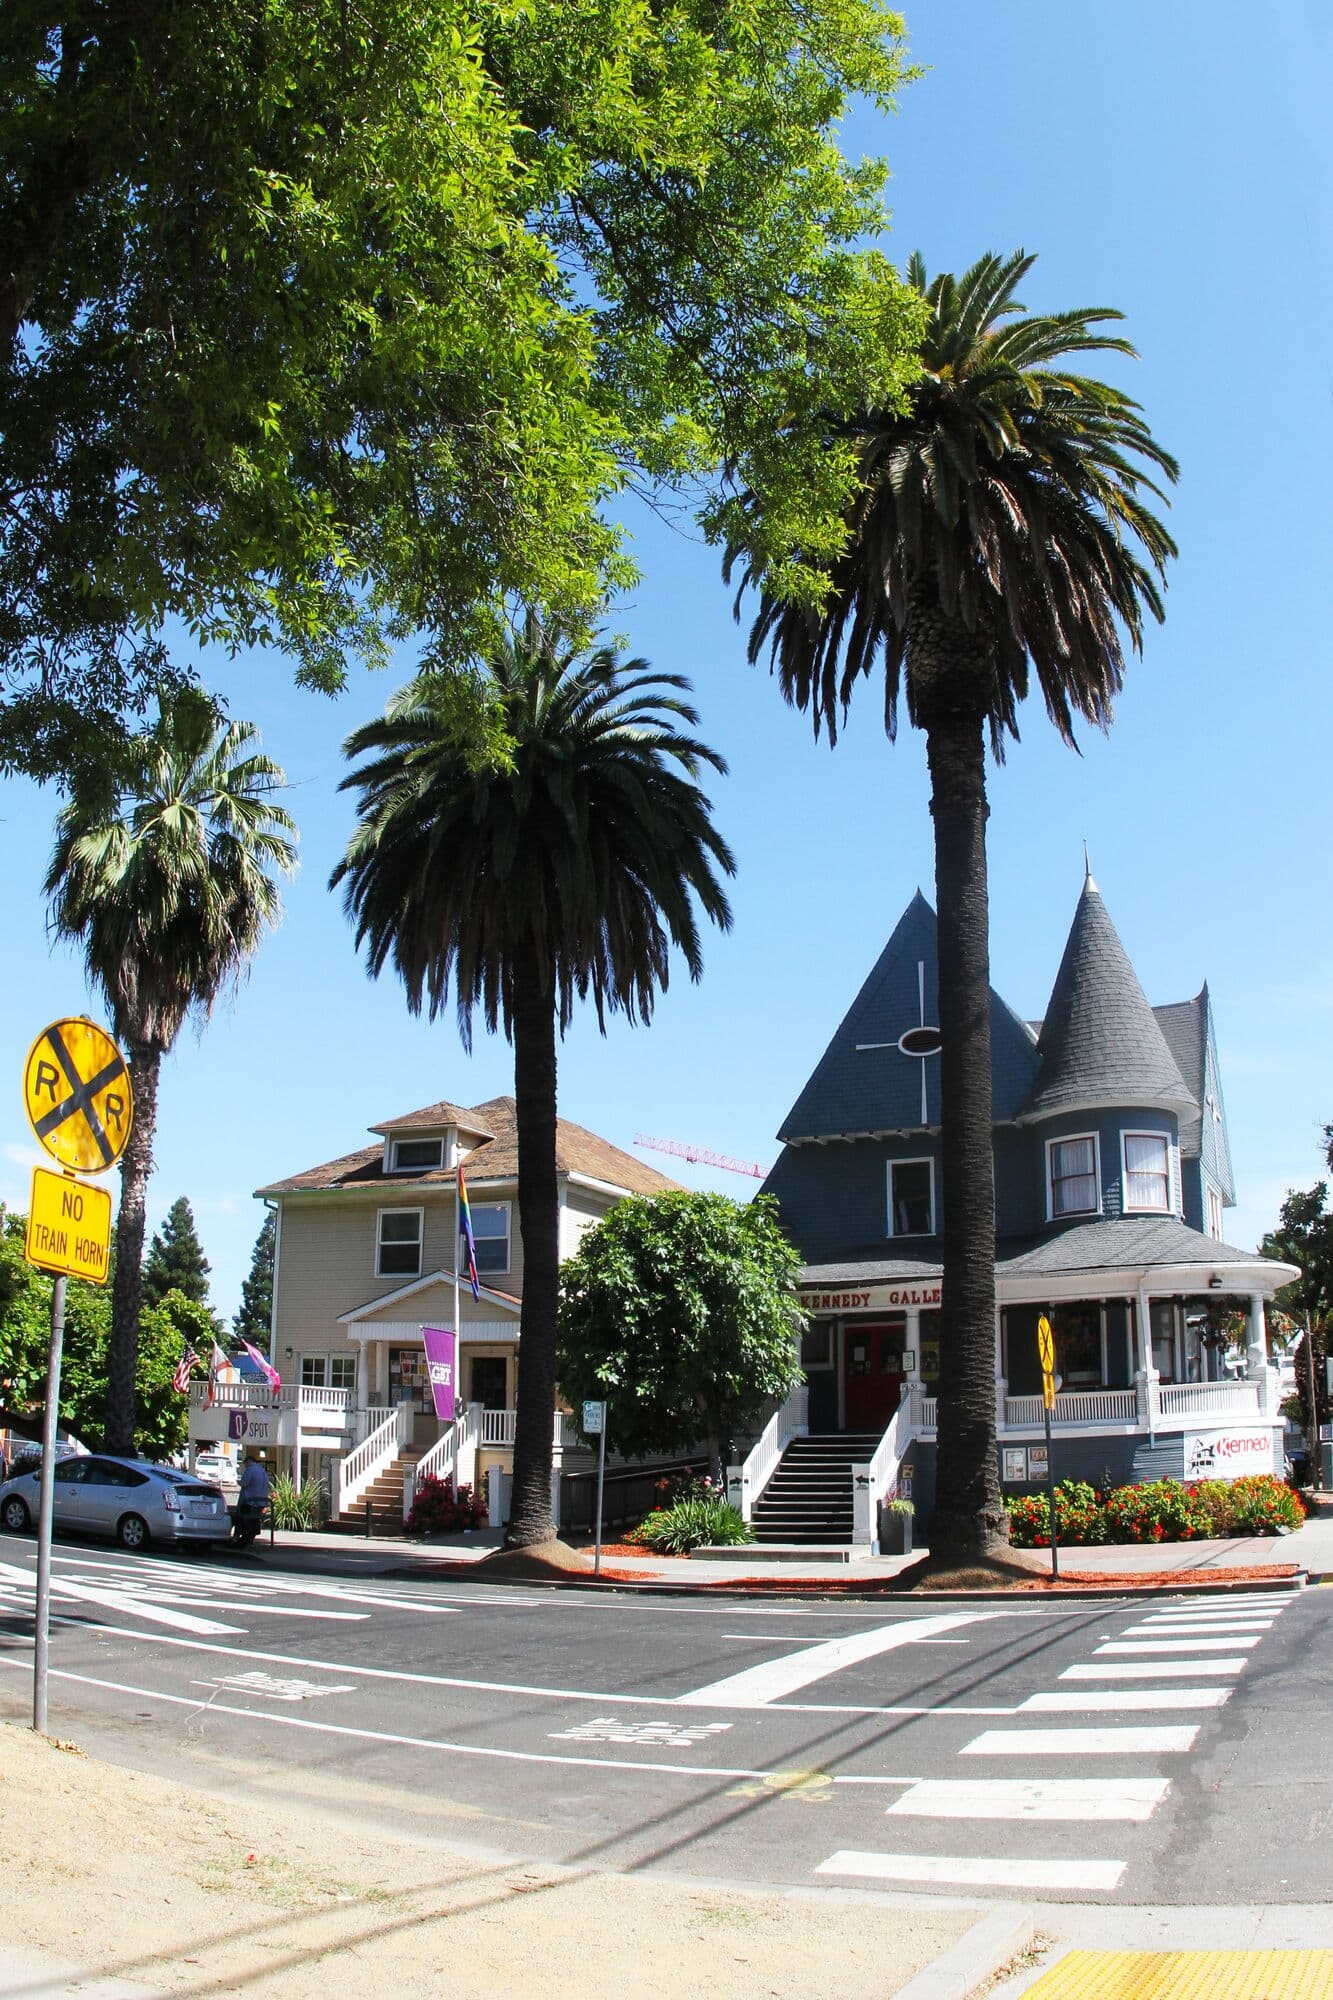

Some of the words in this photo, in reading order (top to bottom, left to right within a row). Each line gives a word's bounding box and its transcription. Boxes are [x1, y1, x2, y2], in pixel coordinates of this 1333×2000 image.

[35, 1060, 59, 1103] R
[105, 1093, 125, 1133] R
[61, 1190, 84, 1222] NO
[35, 1223, 68, 1257] TRAIN
[75, 1236, 104, 1268] HORN
[800, 1292, 871, 1309] KENNEDY
[889, 1288, 942, 1305] GALLE
[248, 1422, 269, 1438] SPOT
[1216, 1435, 1272, 1458] Kennedy
